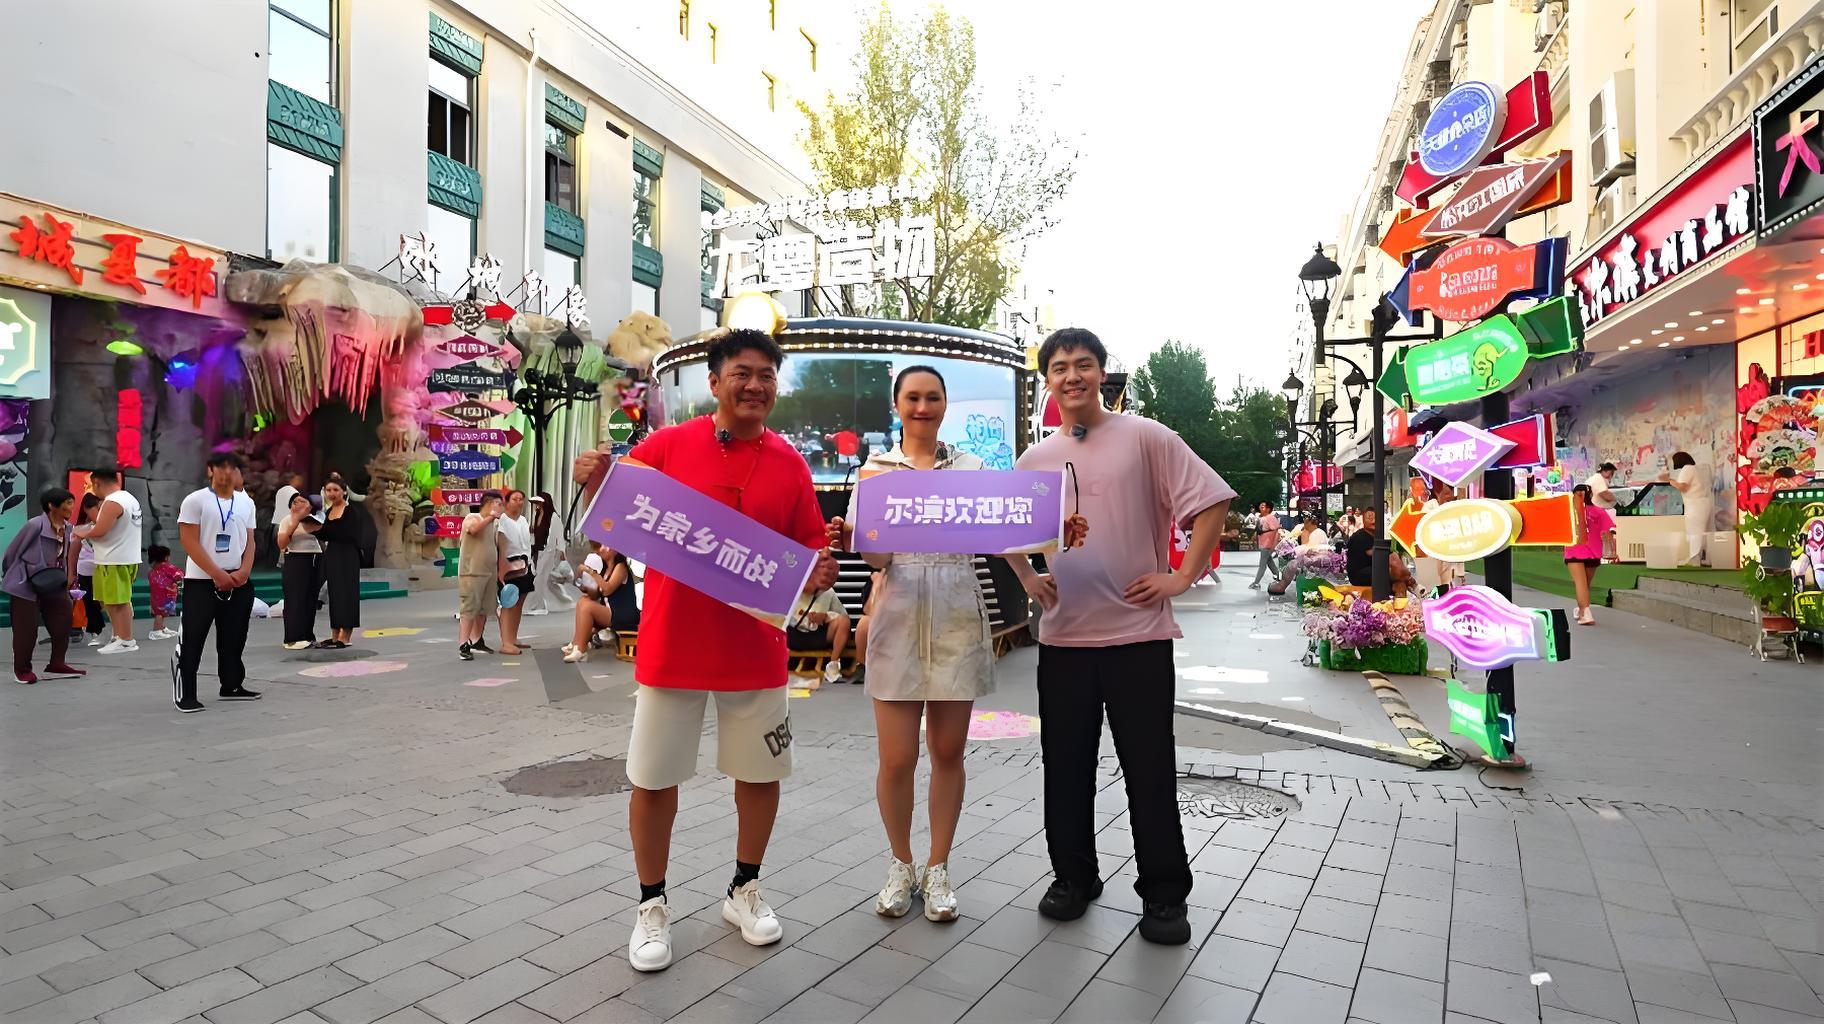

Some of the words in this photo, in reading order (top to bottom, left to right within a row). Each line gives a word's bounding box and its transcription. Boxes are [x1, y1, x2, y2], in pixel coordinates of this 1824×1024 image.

[625, 494, 778, 588] 为家乡而战
